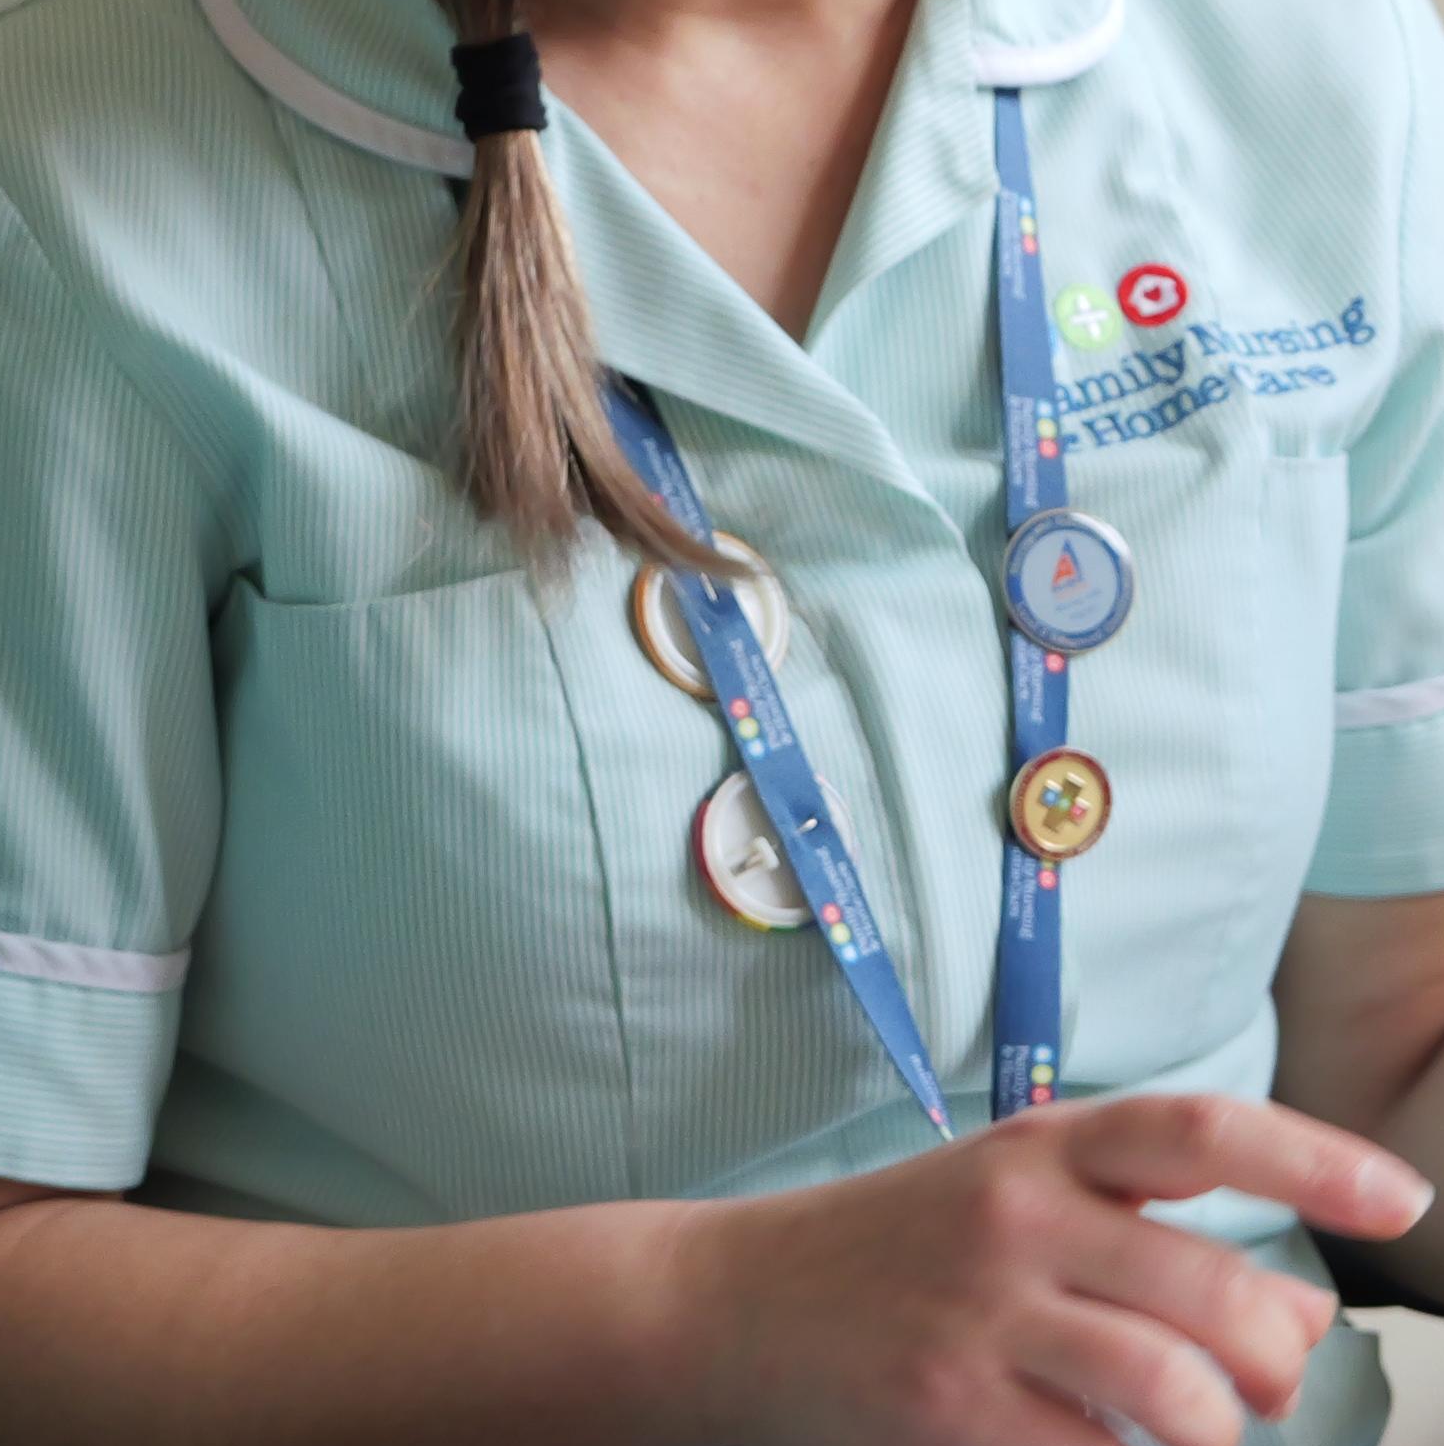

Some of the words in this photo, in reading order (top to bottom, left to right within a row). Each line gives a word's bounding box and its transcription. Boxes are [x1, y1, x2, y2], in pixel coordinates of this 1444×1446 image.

[1056, 341, 1187, 416] amily
[1187, 296, 1375, 358] Nursing
[1083, 372, 1231, 448] Home
[1229, 362, 1337, 395] Care
